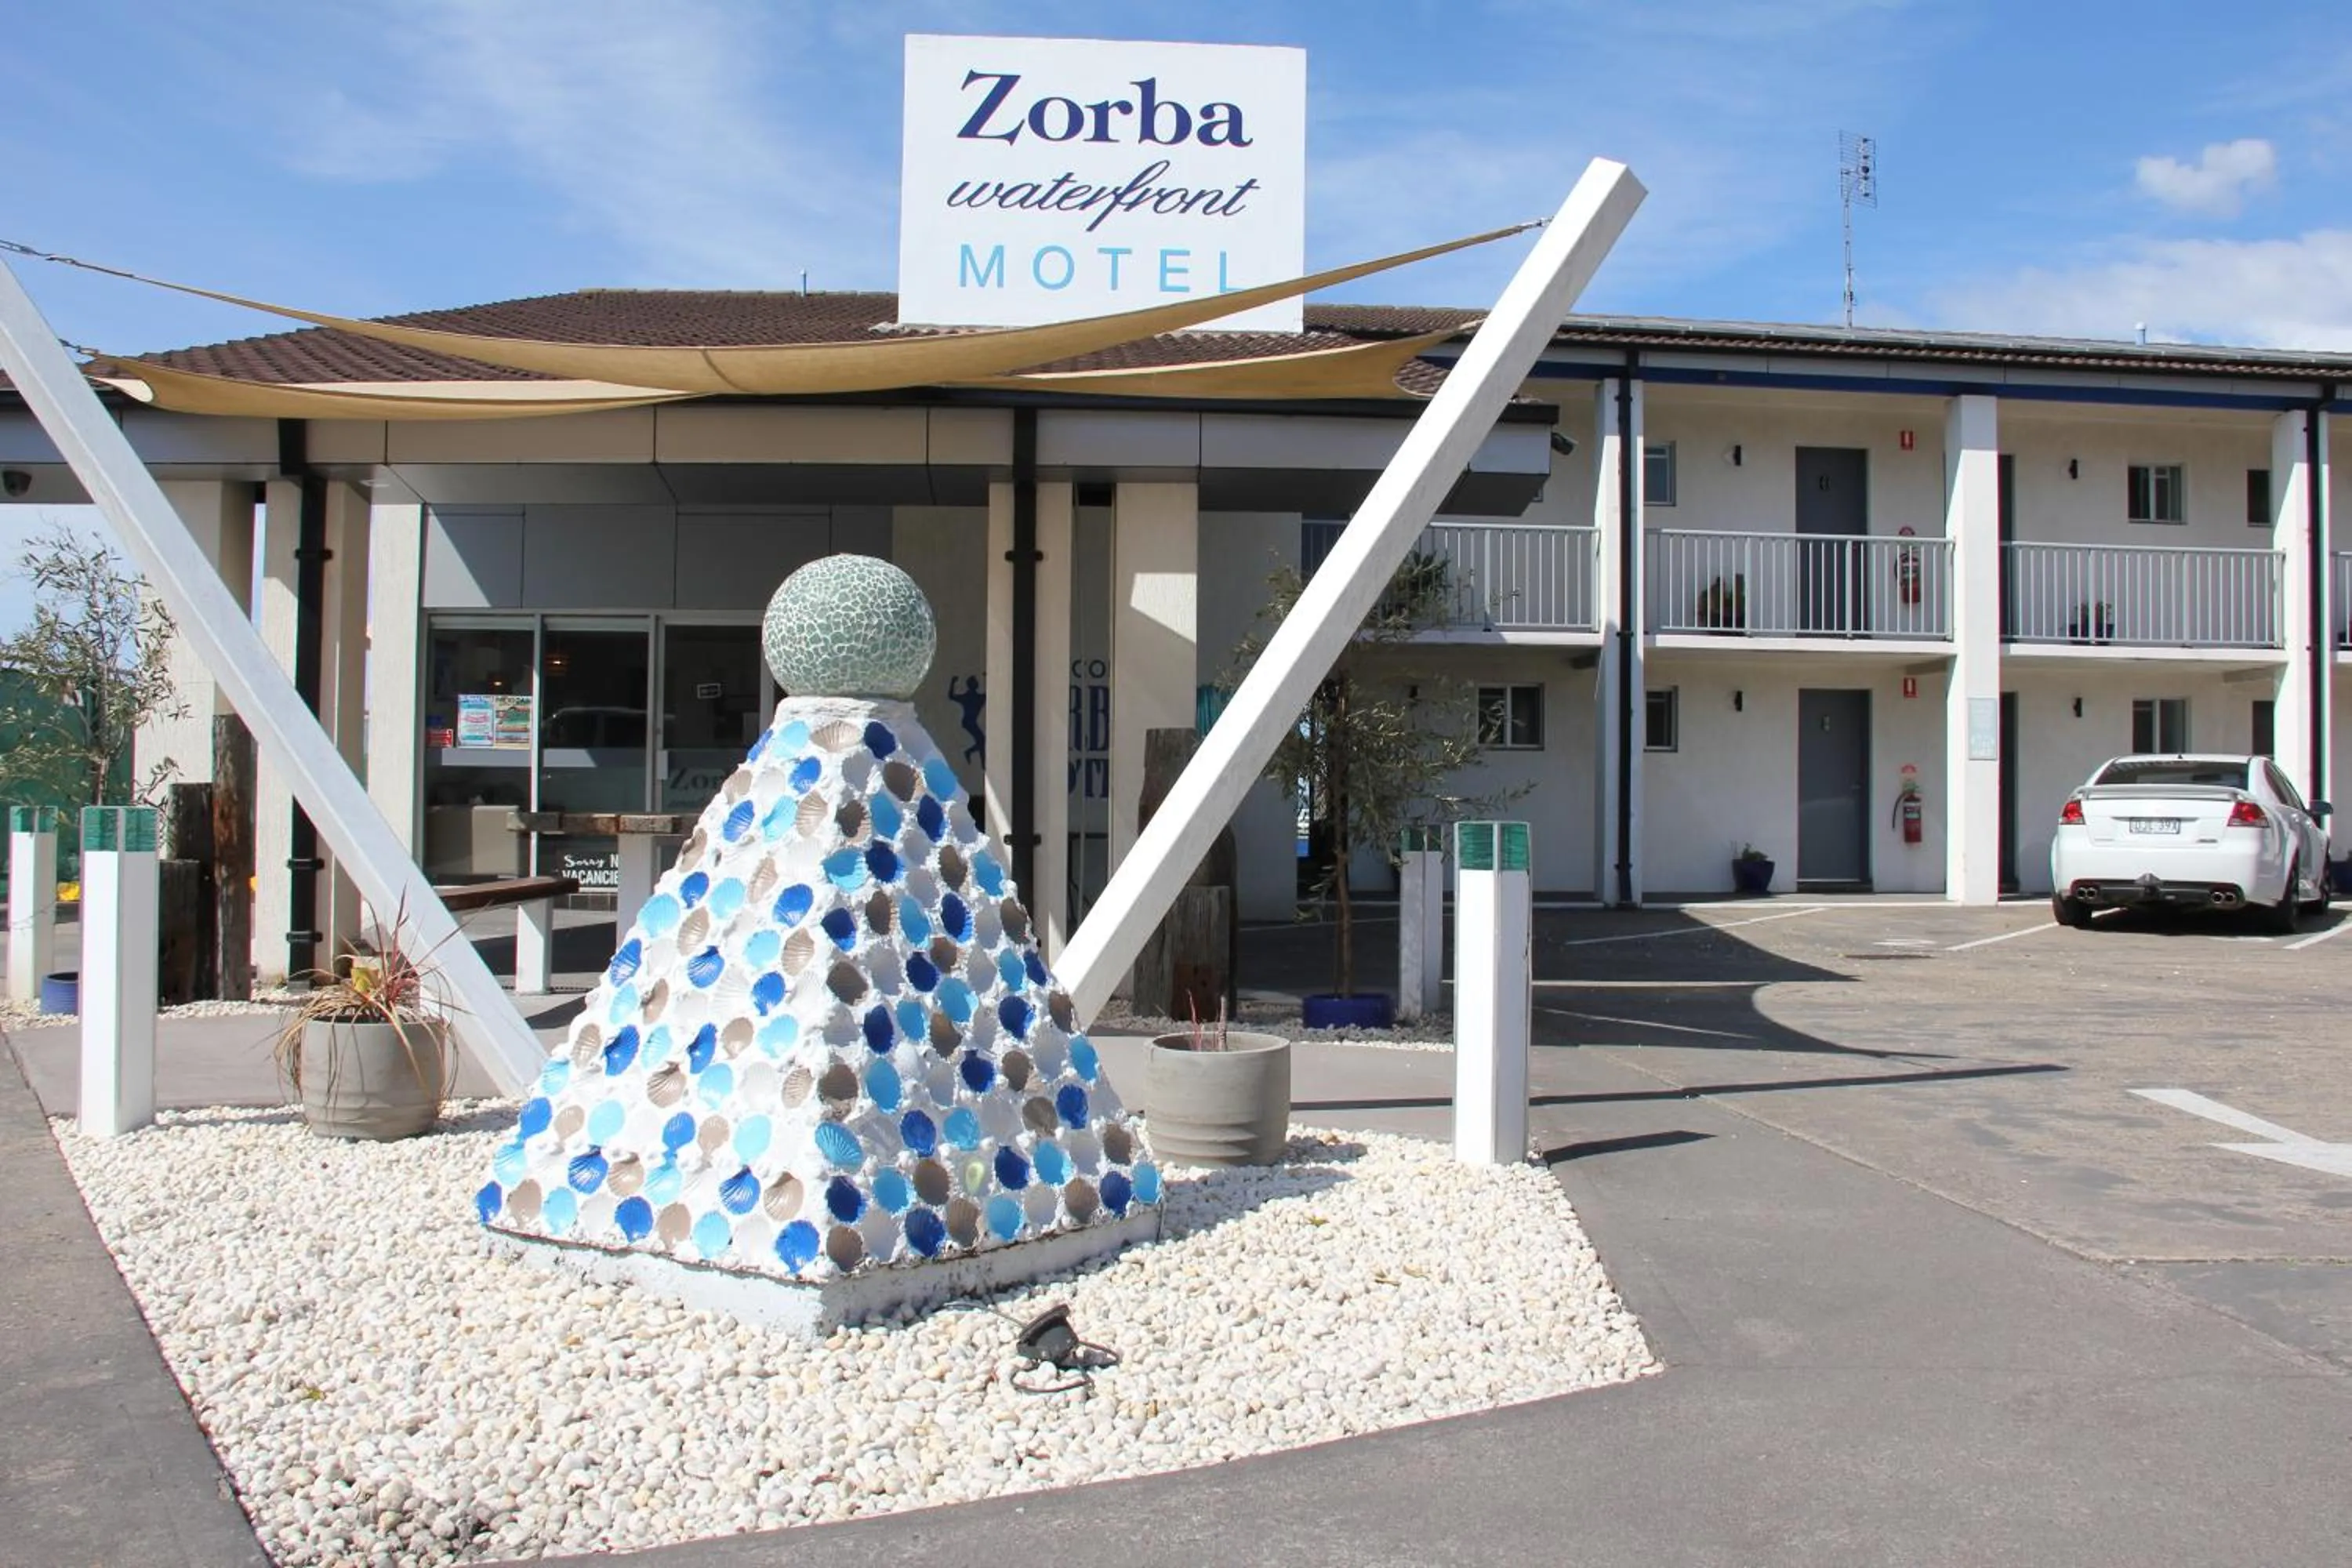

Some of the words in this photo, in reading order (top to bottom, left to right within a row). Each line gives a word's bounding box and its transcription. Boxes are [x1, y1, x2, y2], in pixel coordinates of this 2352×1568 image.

[956, 69, 1254, 147] Zorba
[946, 159, 1261, 232] waterfront
[959, 244, 1243, 293] MOTEL
[670, 766, 722, 791] Zor
[561, 869, 619, 885] VACANCIE
[564, 854, 604, 868] Sorry
[610, 853, 619, 868] N
